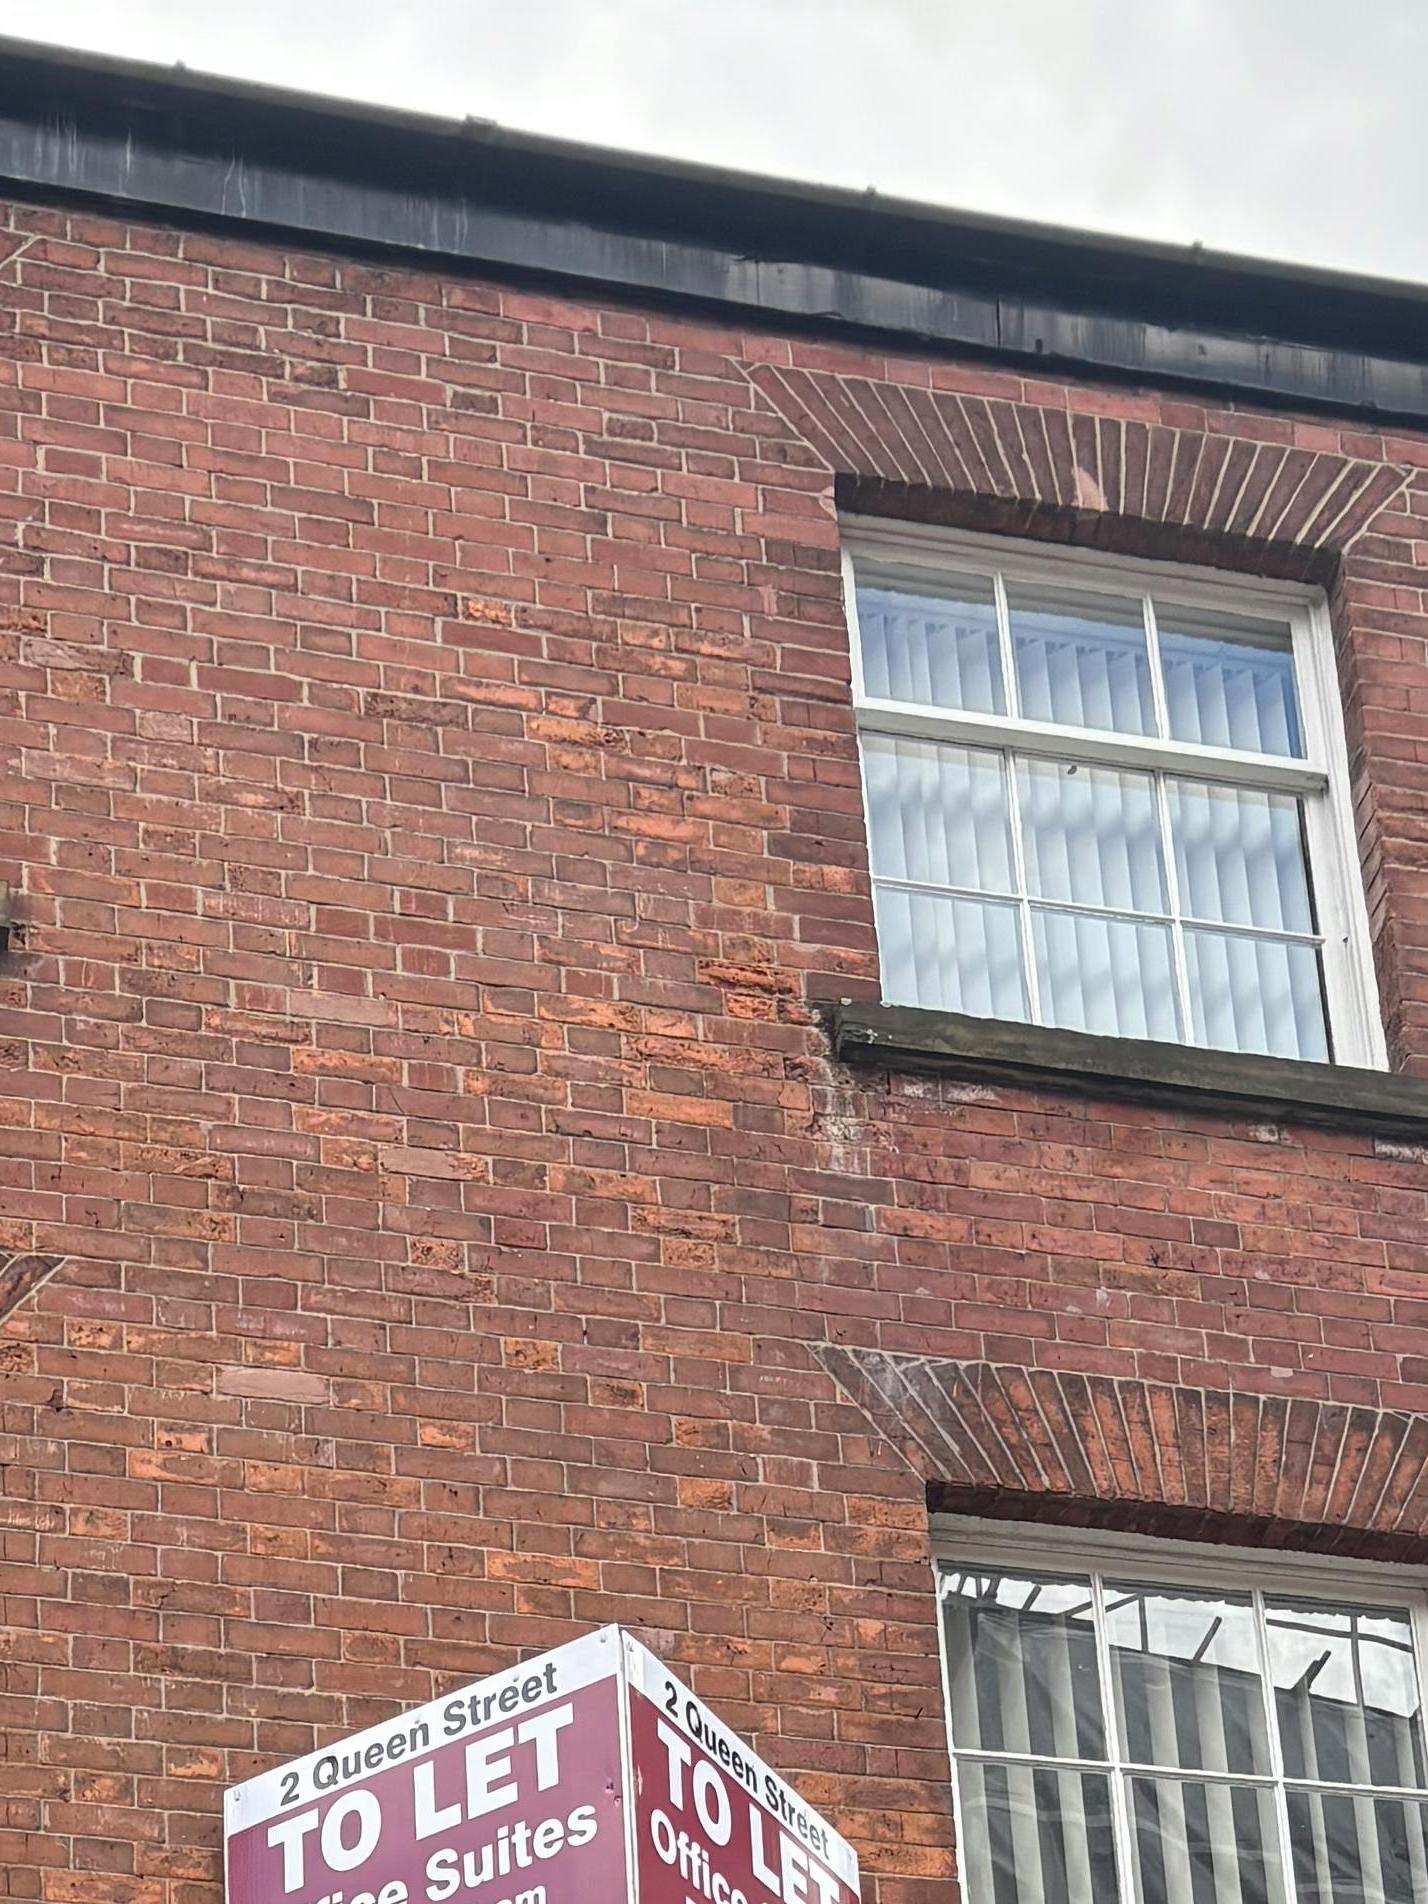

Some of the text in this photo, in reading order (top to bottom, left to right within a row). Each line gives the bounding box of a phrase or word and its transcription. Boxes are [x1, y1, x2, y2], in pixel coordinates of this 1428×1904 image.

[267, 1703, 574, 1894] TO LET
[280, 1662, 558, 1806] 2 Queen Street
[657, 1718, 732, 1846] TO
[664, 1680, 830, 1860] 2 Queen Street
[425, 1804, 598, 1901] Suites
